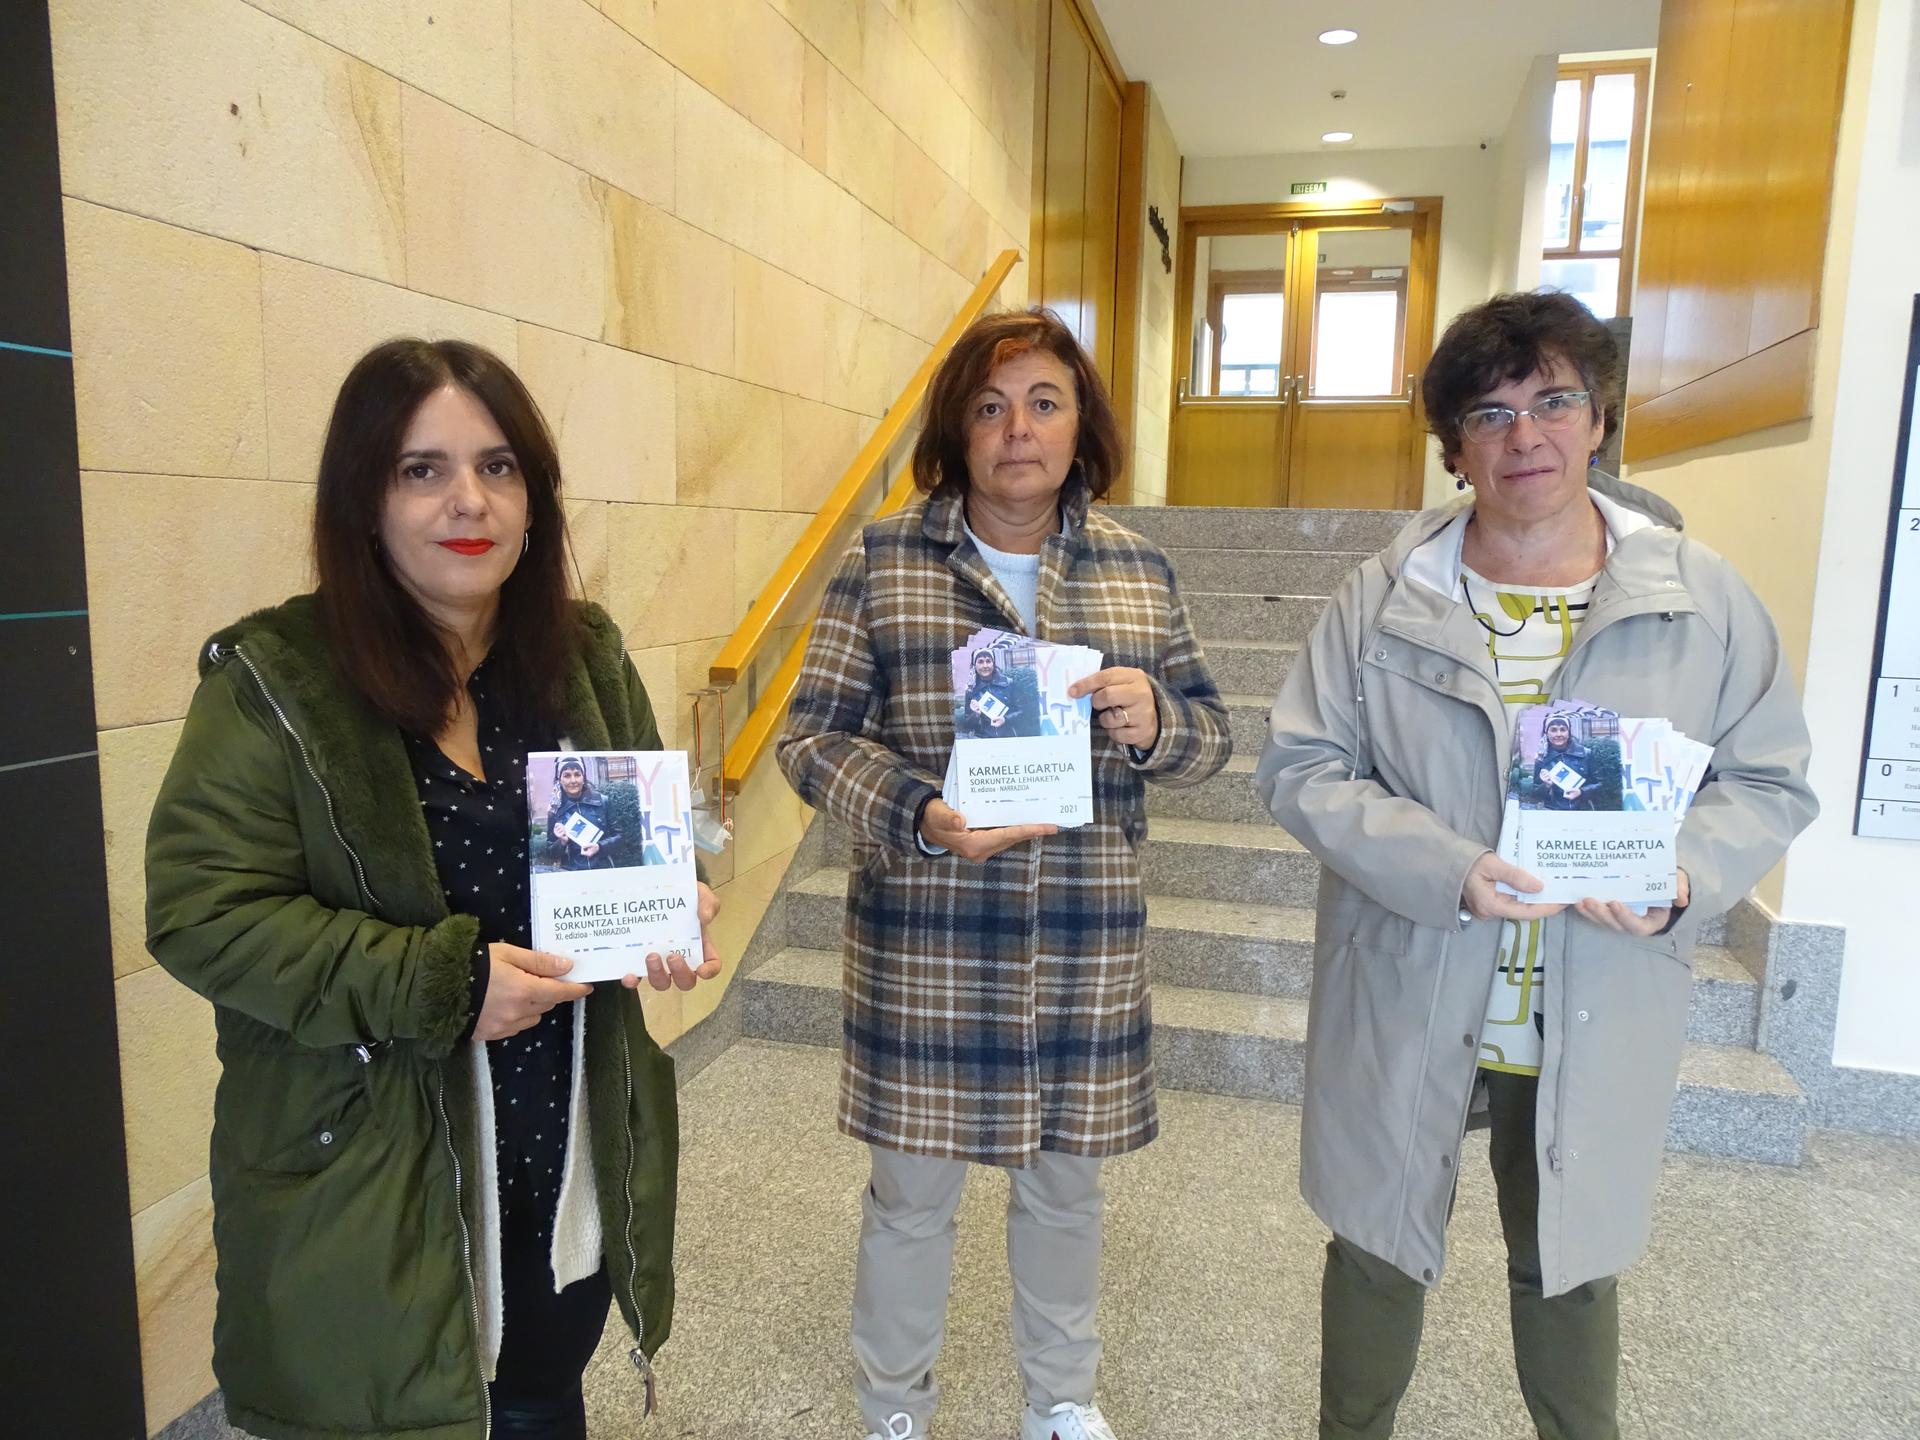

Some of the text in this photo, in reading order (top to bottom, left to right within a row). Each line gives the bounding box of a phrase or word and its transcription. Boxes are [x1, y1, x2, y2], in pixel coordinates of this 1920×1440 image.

[1293, 183, 1324, 194] IRTEERA
[1910, 517, 1920, 531] 2
[1893, 684, 1899, 698] 1
[969, 762, 1075, 777] KARMELE IGARTUA
[1881, 763, 1892, 777] 0
[970, 775, 1060, 786] SORKUNTZA LEHIAKETA
[1060, 804, 1078, 814] 2021
[1872, 803, 1885, 816] -1
[1536, 839, 1665, 851] KARMELE IGARTUA
[1537, 851, 1646, 860] SORKUNTZA LEHIAKETA
[1645, 881, 1668, 892] 2021
[553, 897, 686, 920] KARMELE IGARTUA
[554, 913, 669, 932] SORKUNTZA LEHIAKETA
[593, 926, 631, 937] NARRAZIOA
